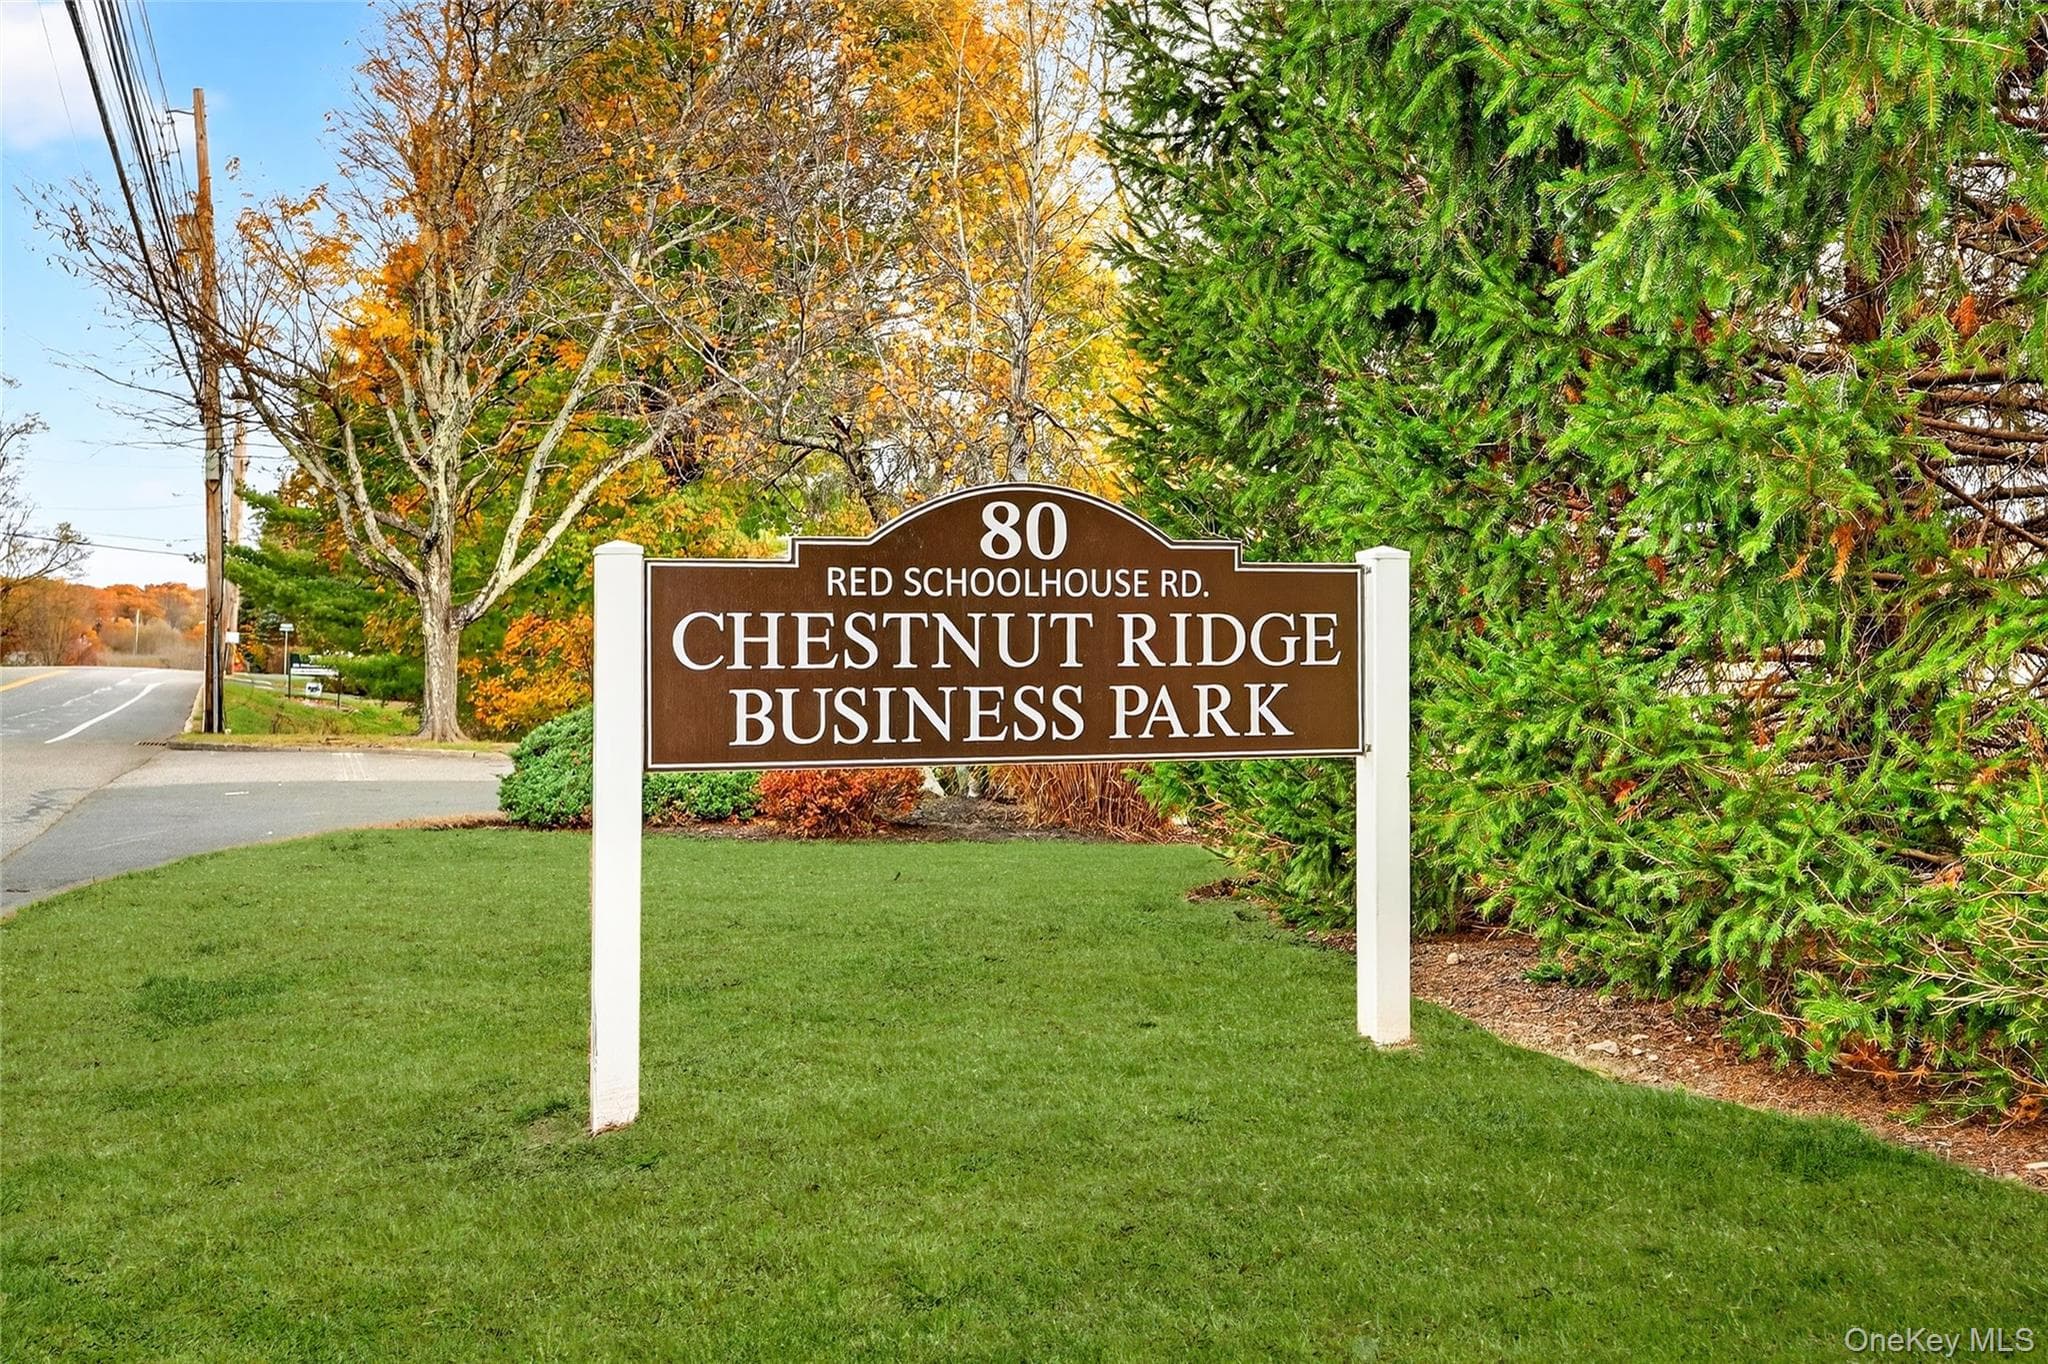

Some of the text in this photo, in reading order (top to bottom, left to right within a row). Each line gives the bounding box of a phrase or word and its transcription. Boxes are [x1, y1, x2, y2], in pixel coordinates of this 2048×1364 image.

[979, 501, 1068, 561] 80
[827, 566, 1209, 598] RED SCHOOLHOUSE RD.
[672, 611, 1342, 671] CHESTNUT RIDGE
[728, 683, 1295, 746] BUSINESS PARK
